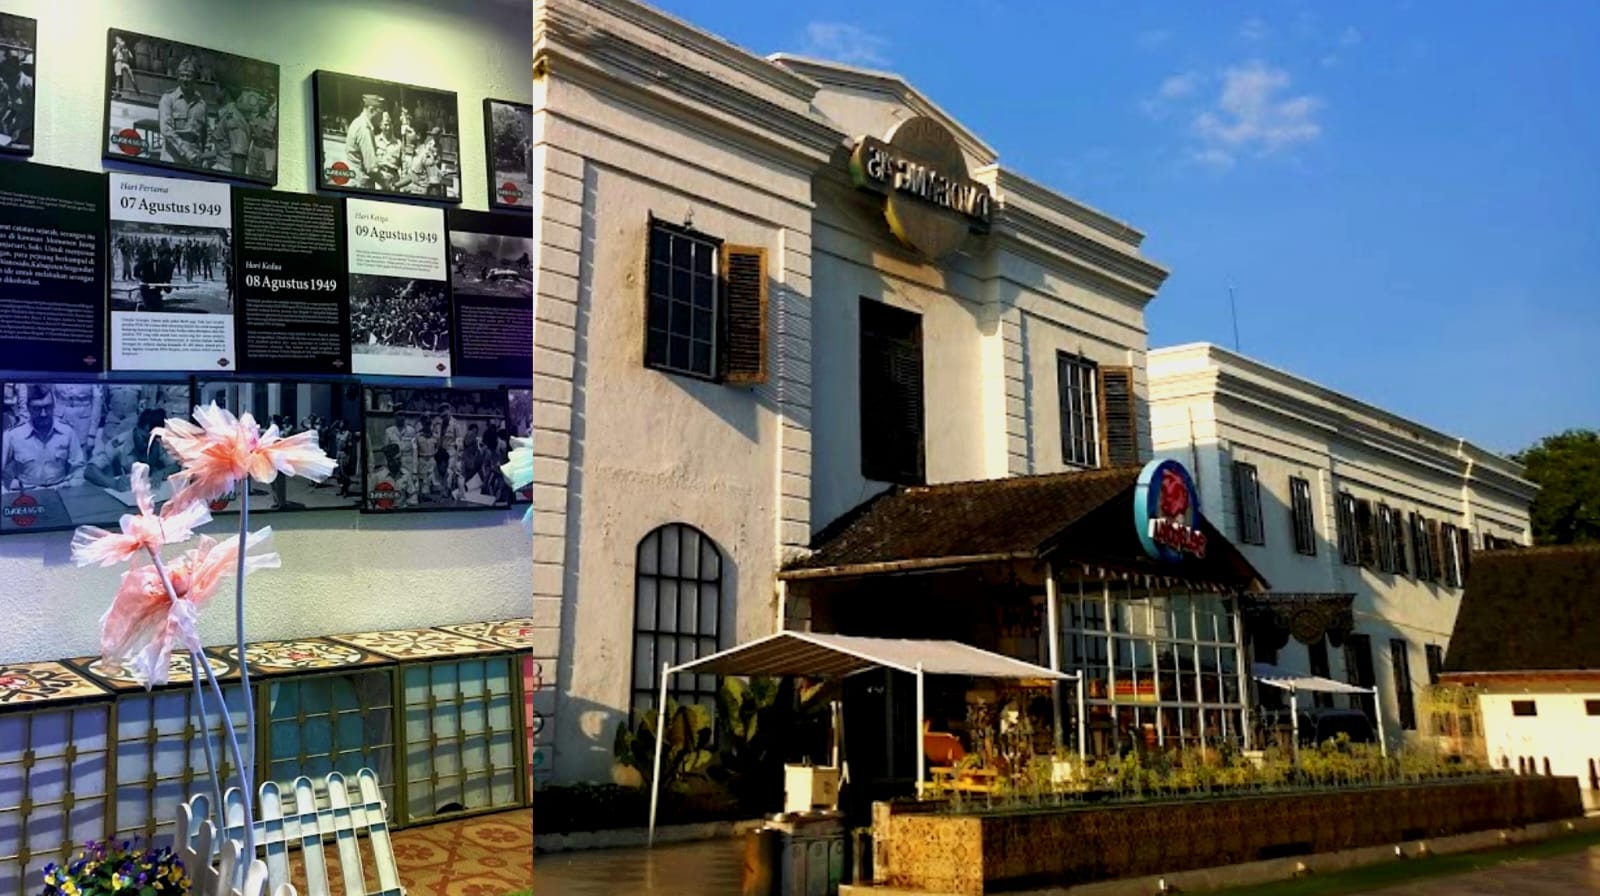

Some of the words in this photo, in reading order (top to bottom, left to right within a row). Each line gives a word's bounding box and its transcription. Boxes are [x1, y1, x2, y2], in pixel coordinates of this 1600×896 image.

[120, 181, 138, 191] Hari
[139, 184, 169, 194] Pertama
[120, 196, 137, 208] 07
[138, 197, 191, 215] Agustus
[193, 202, 222, 216] 1949
[355, 225, 369, 237] 09
[370, 226, 413, 242] Agustus
[414, 231, 438, 244] 1949
[245, 274, 261, 287] 08
[262, 275, 309, 292] Agustus
[310, 278, 337, 292] 1949
